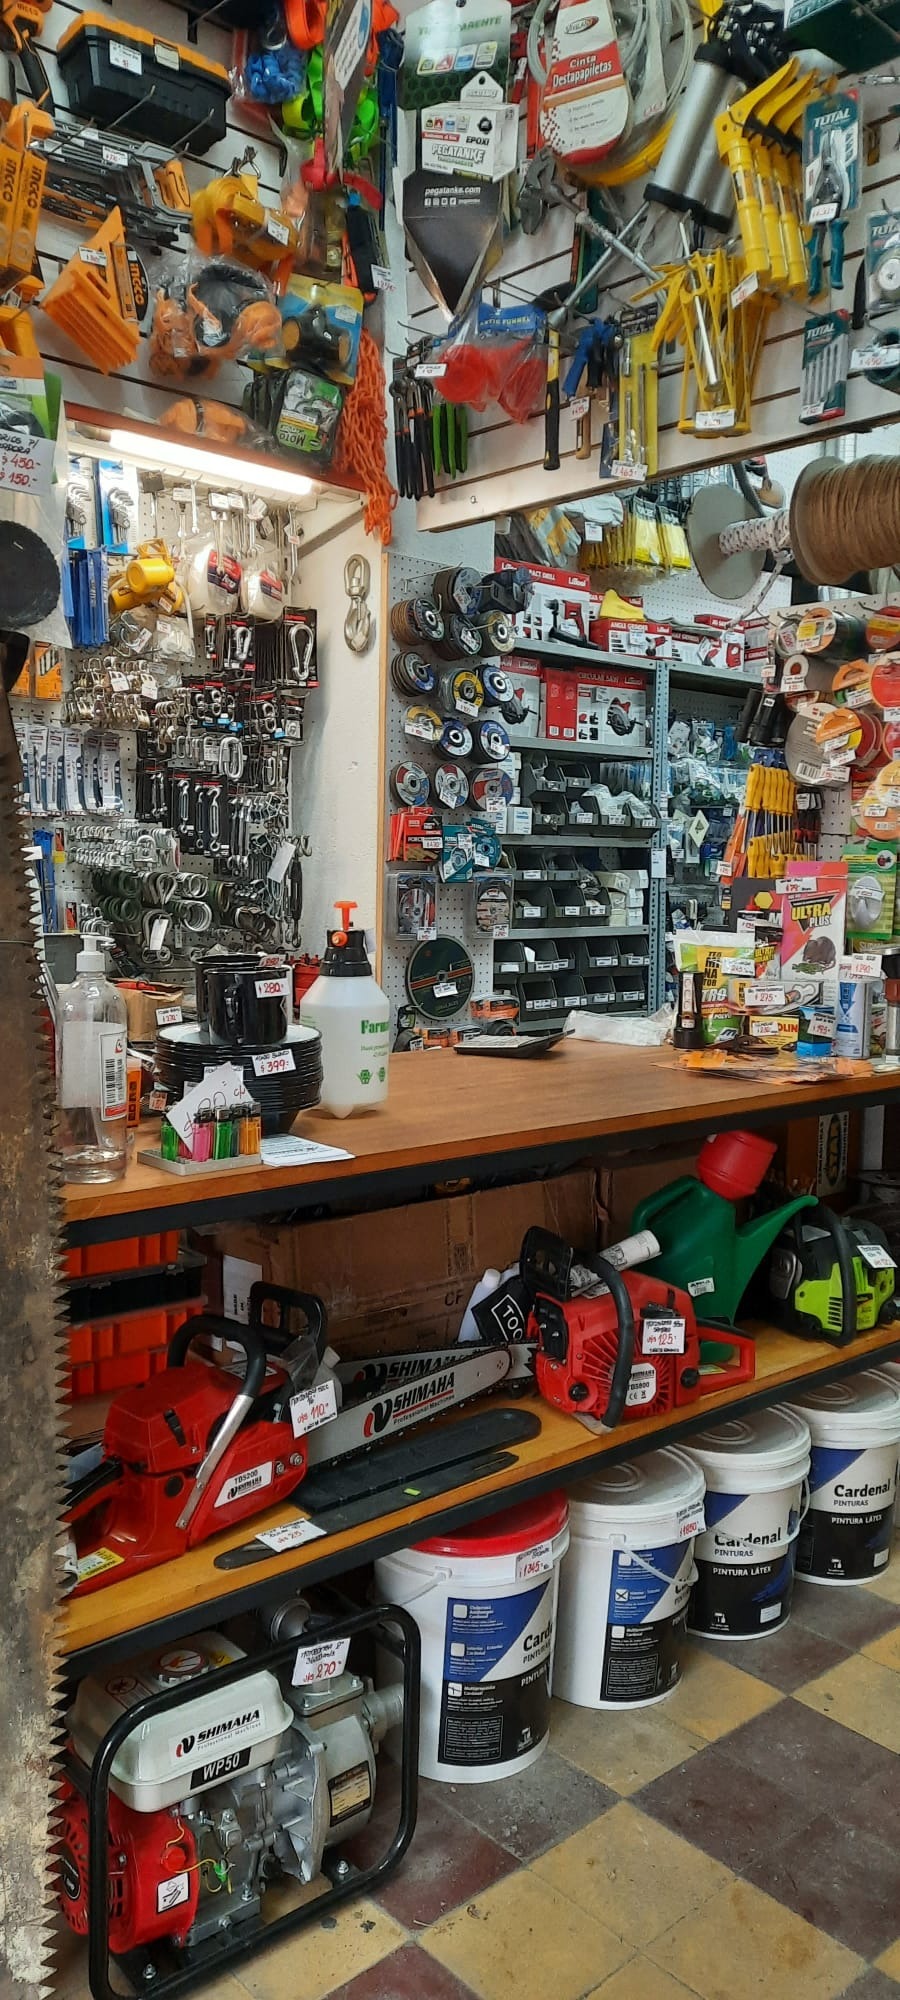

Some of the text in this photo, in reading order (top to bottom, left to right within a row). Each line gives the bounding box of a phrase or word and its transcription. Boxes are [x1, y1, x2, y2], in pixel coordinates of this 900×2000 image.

[570, 55, 597, 69] Cinta
[553, 60, 612, 87] Destapapiletas
[814, 108, 851, 128] TOTAL
[466, 136, 490, 146] EPOXI
[431, 143, 485, 163] PEGATANKE
[425, 186, 481, 196] pegatanke.com
[807, 323, 835, 340] TOTAL
[791, 902, 832, 921] ULTRA
[809, 914, 832, 928] PLUS
[704, 968, 718, 979] NA
[386, 1354, 458, 1378] SHIMA
[392, 1372, 456, 1413] SHIMAHA
[834, 1478, 890, 1498] Cardenal
[833, 1499, 869, 1507] PINTURAS
[831, 1515, 863, 1525] PINTURA
[715, 1527, 781, 1547] Cardenal
[715, 1549, 753, 1557] PINTURAS
[713, 1567, 748, 1577] PINTURA
[523, 1621, 553, 1652] Card
[197, 1709, 260, 1741] SHIMAHA
[197, 1733, 233, 1751] Professional
[202, 1752, 240, 1781] WP50
